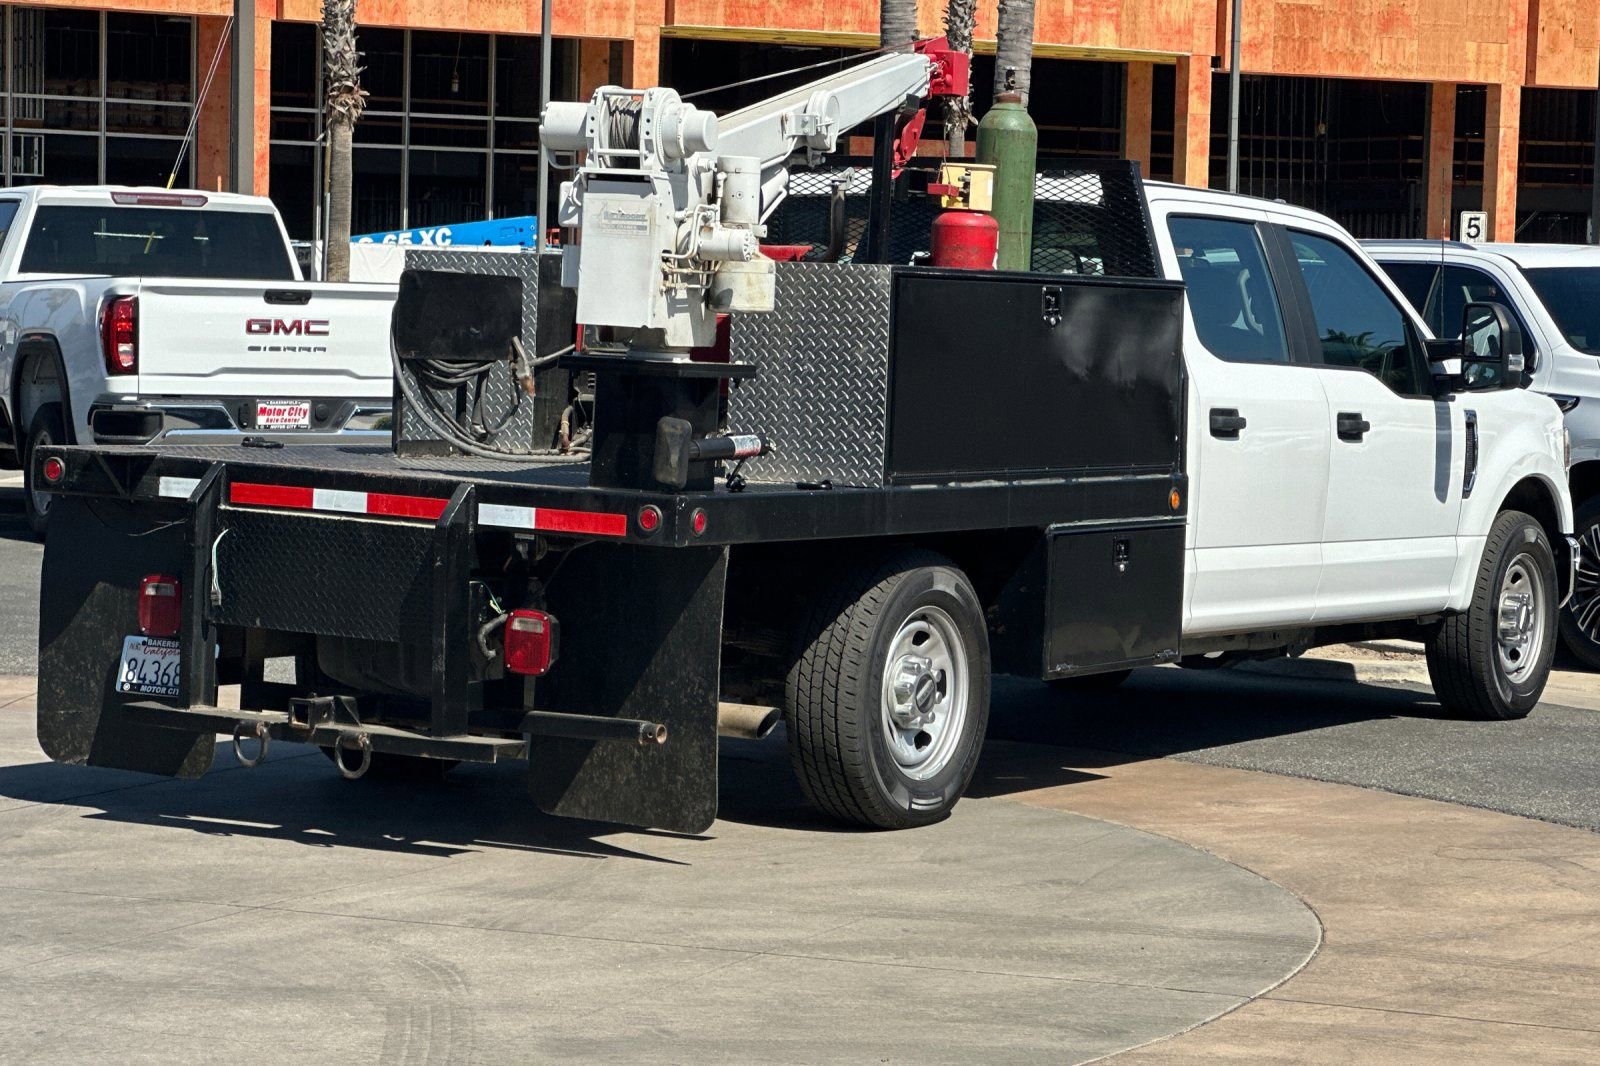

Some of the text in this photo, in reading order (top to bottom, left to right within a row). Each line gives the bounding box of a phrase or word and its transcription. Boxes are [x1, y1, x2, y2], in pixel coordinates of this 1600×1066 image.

[419, 227, 452, 247] XC
[1466, 217, 1480, 239] 5
[246, 318, 329, 336] GMC
[257, 406, 308, 419] Motor City
[140, 685, 166, 694] MOTOR
